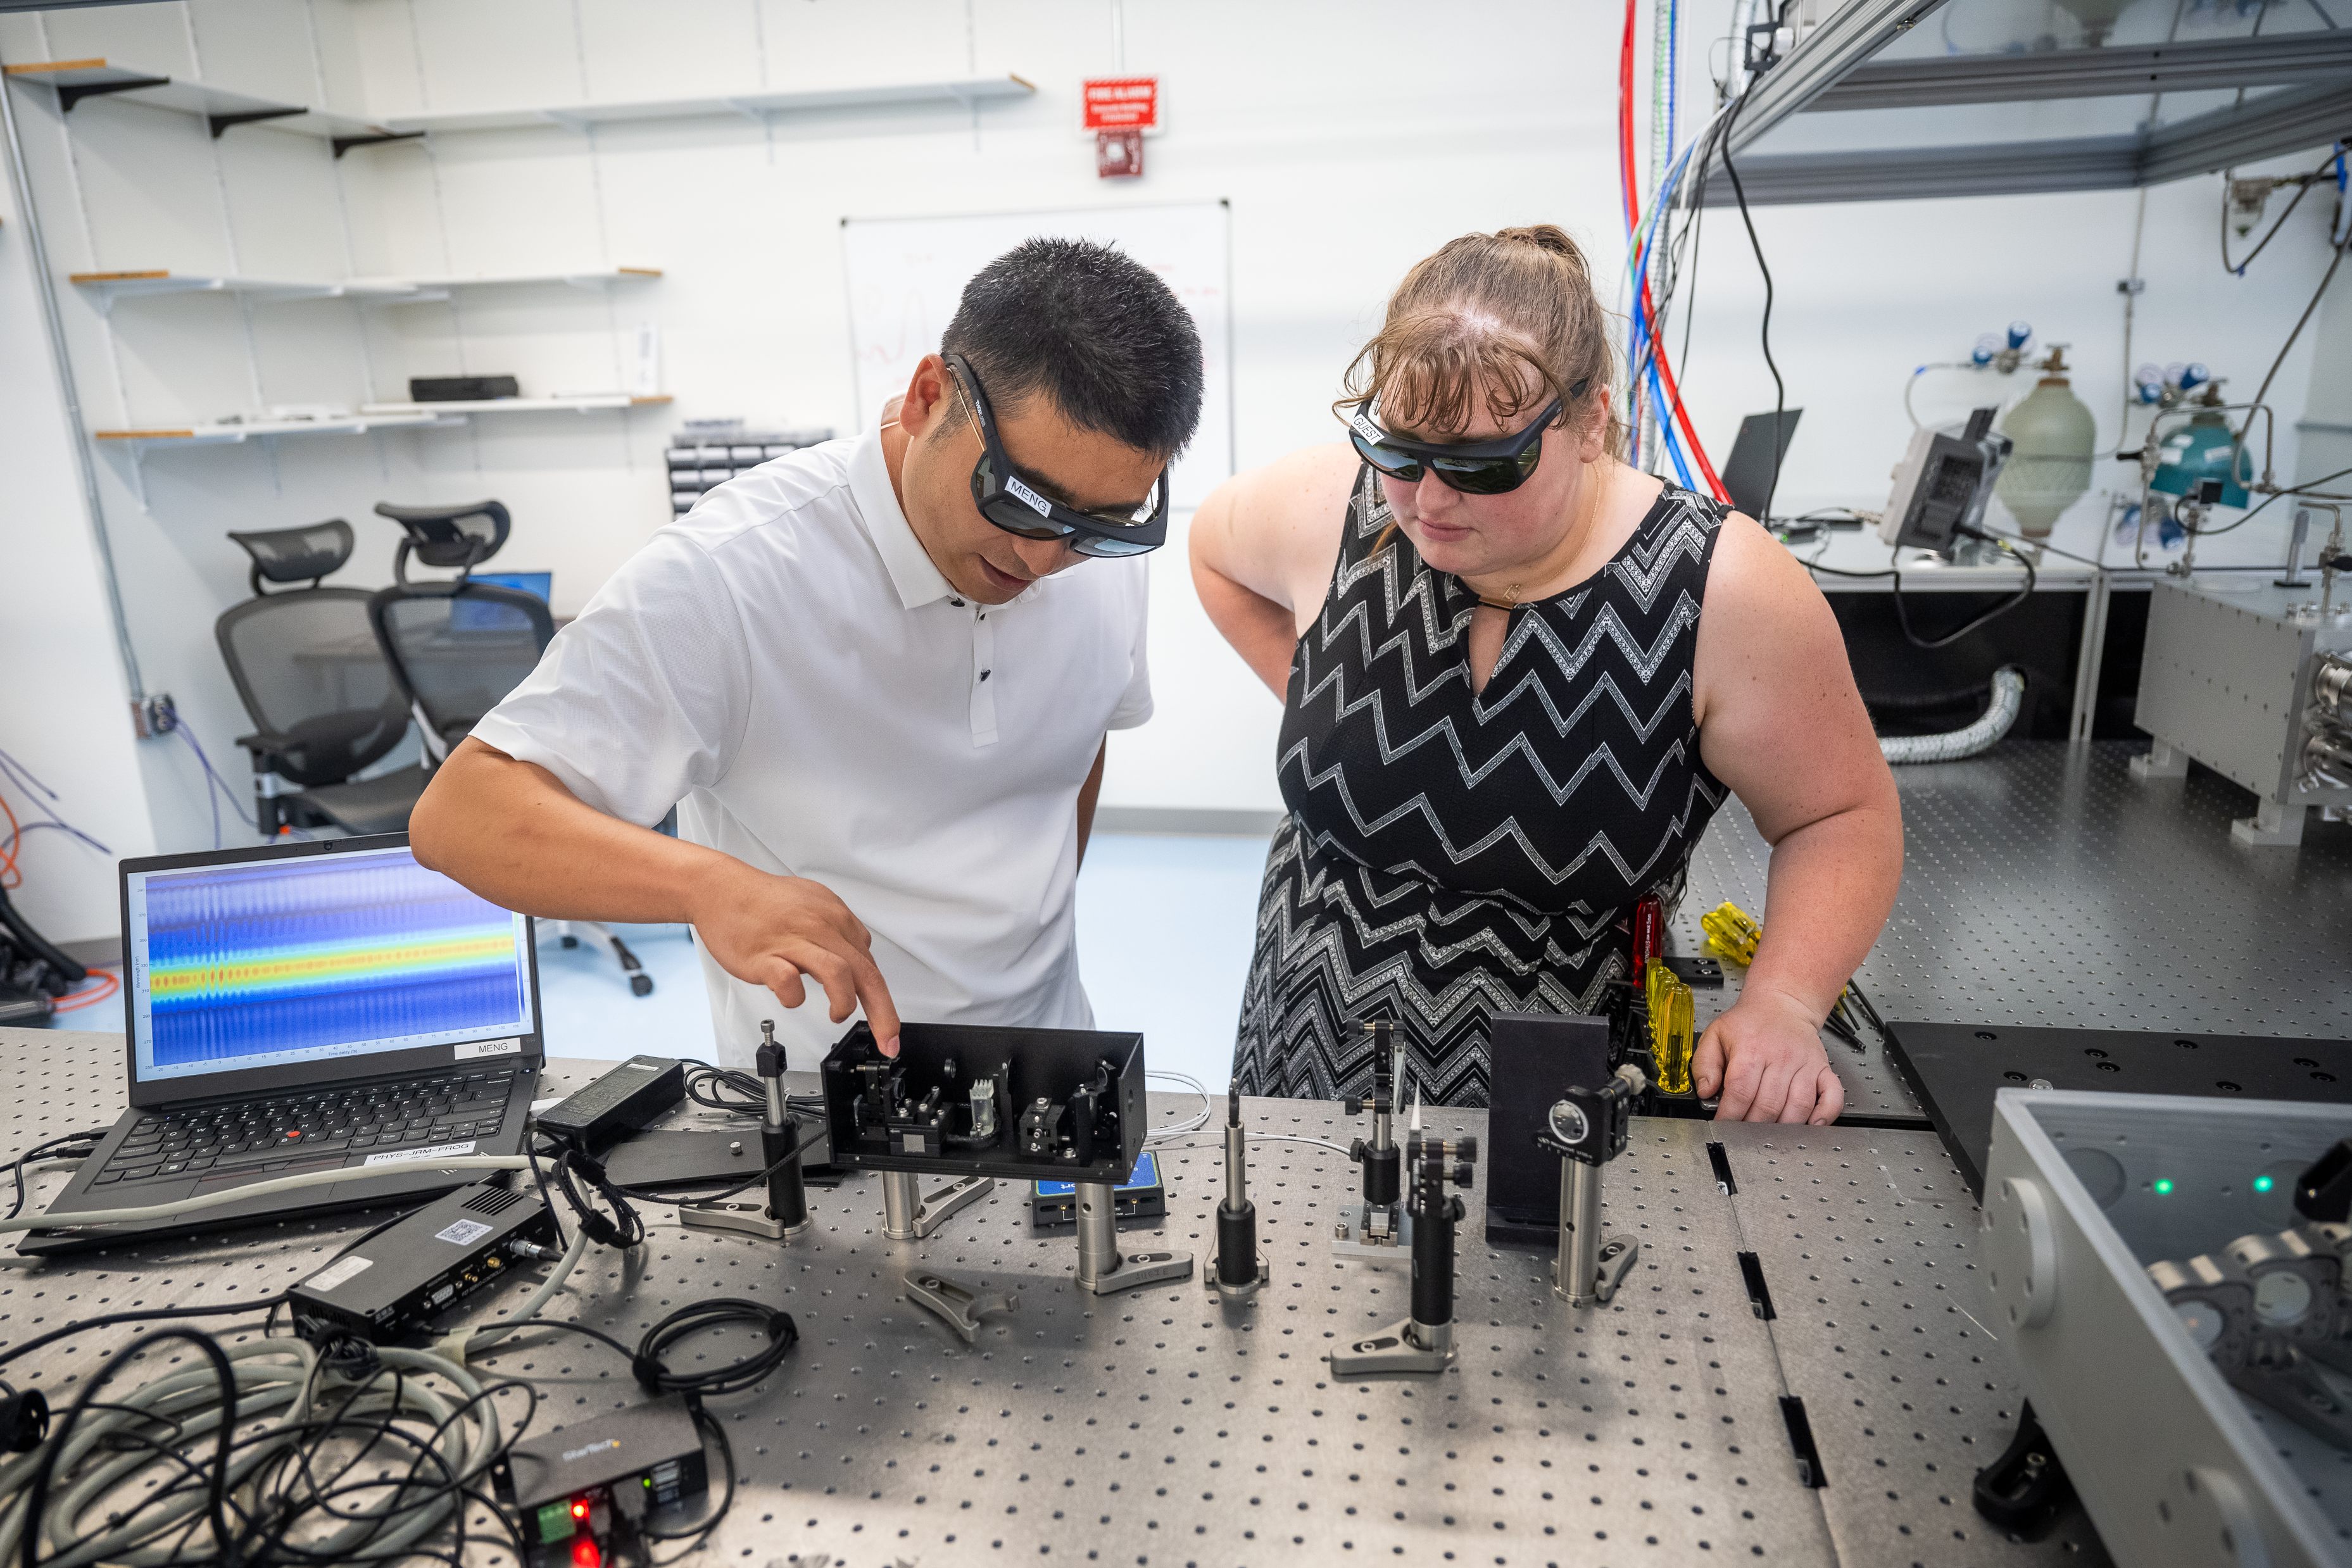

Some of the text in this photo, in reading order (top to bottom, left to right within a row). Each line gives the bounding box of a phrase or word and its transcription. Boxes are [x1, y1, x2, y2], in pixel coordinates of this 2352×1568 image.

[1354, 418, 1381, 441] GUEST
[1010, 480, 1047, 513] MENG
[479, 1043, 508, 1053] MENG
[374, 1143, 469, 1160] PHYS-JRM-FROG
